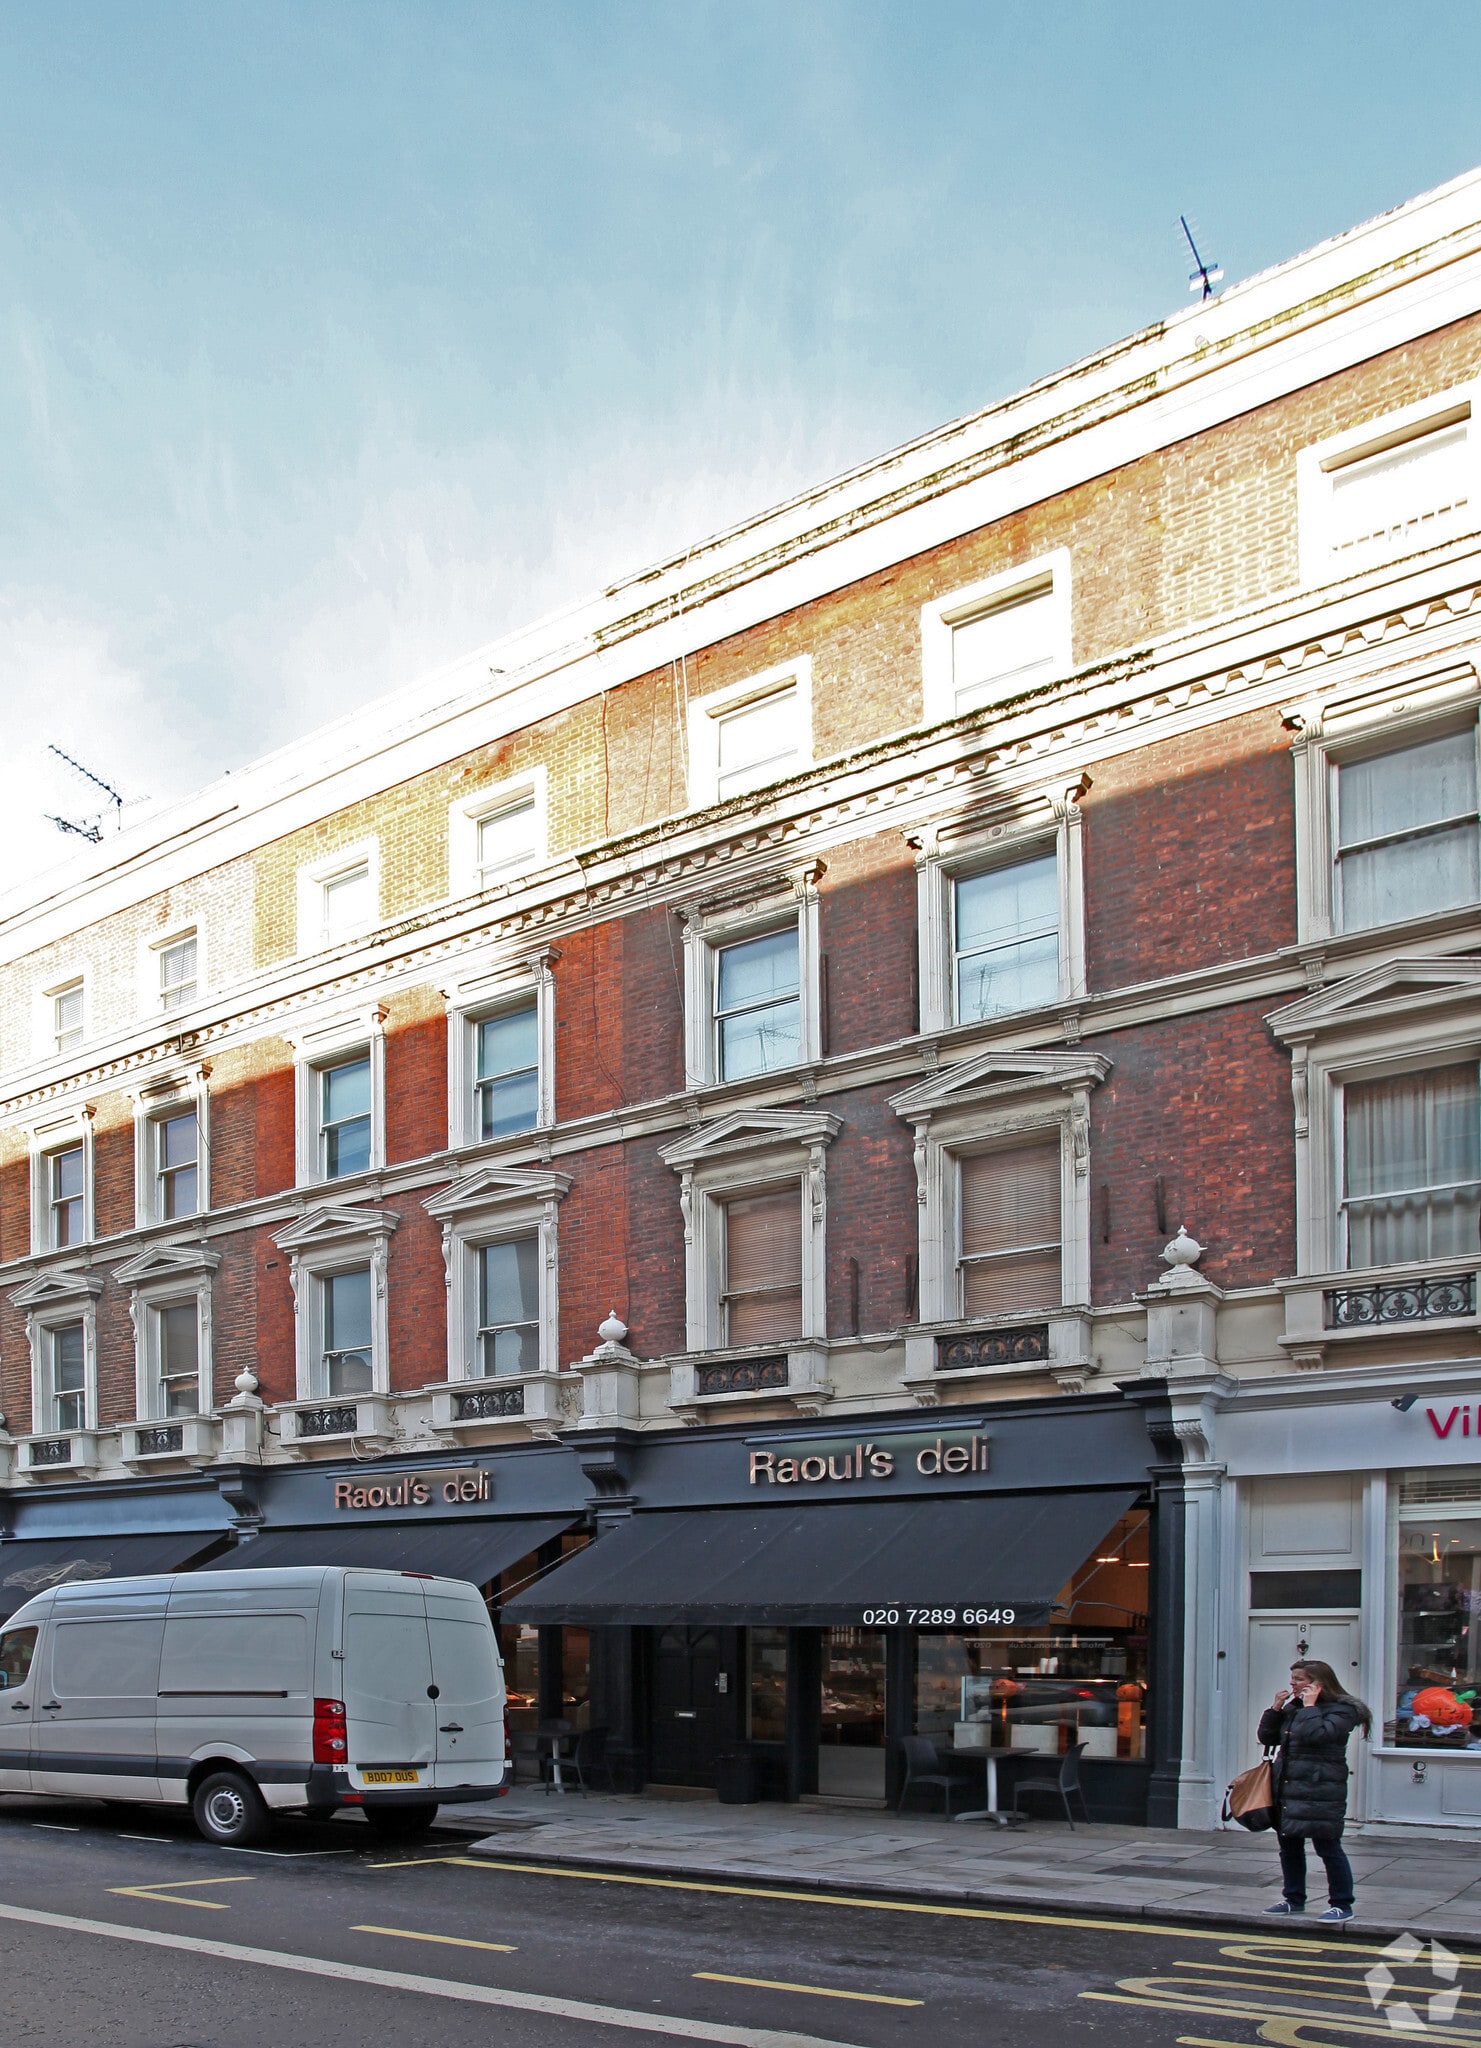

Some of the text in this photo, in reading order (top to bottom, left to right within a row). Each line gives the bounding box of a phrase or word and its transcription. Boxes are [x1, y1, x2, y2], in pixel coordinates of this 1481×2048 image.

[750, 1434, 989, 1484] Raoul's deli
[335, 1470, 491, 1509] Raoul's deli
[863, 1608, 1015, 1625] 020 7289 6649
[1300, 1624, 1307, 1633] 6
[368, 1772, 392, 1782] BD07
